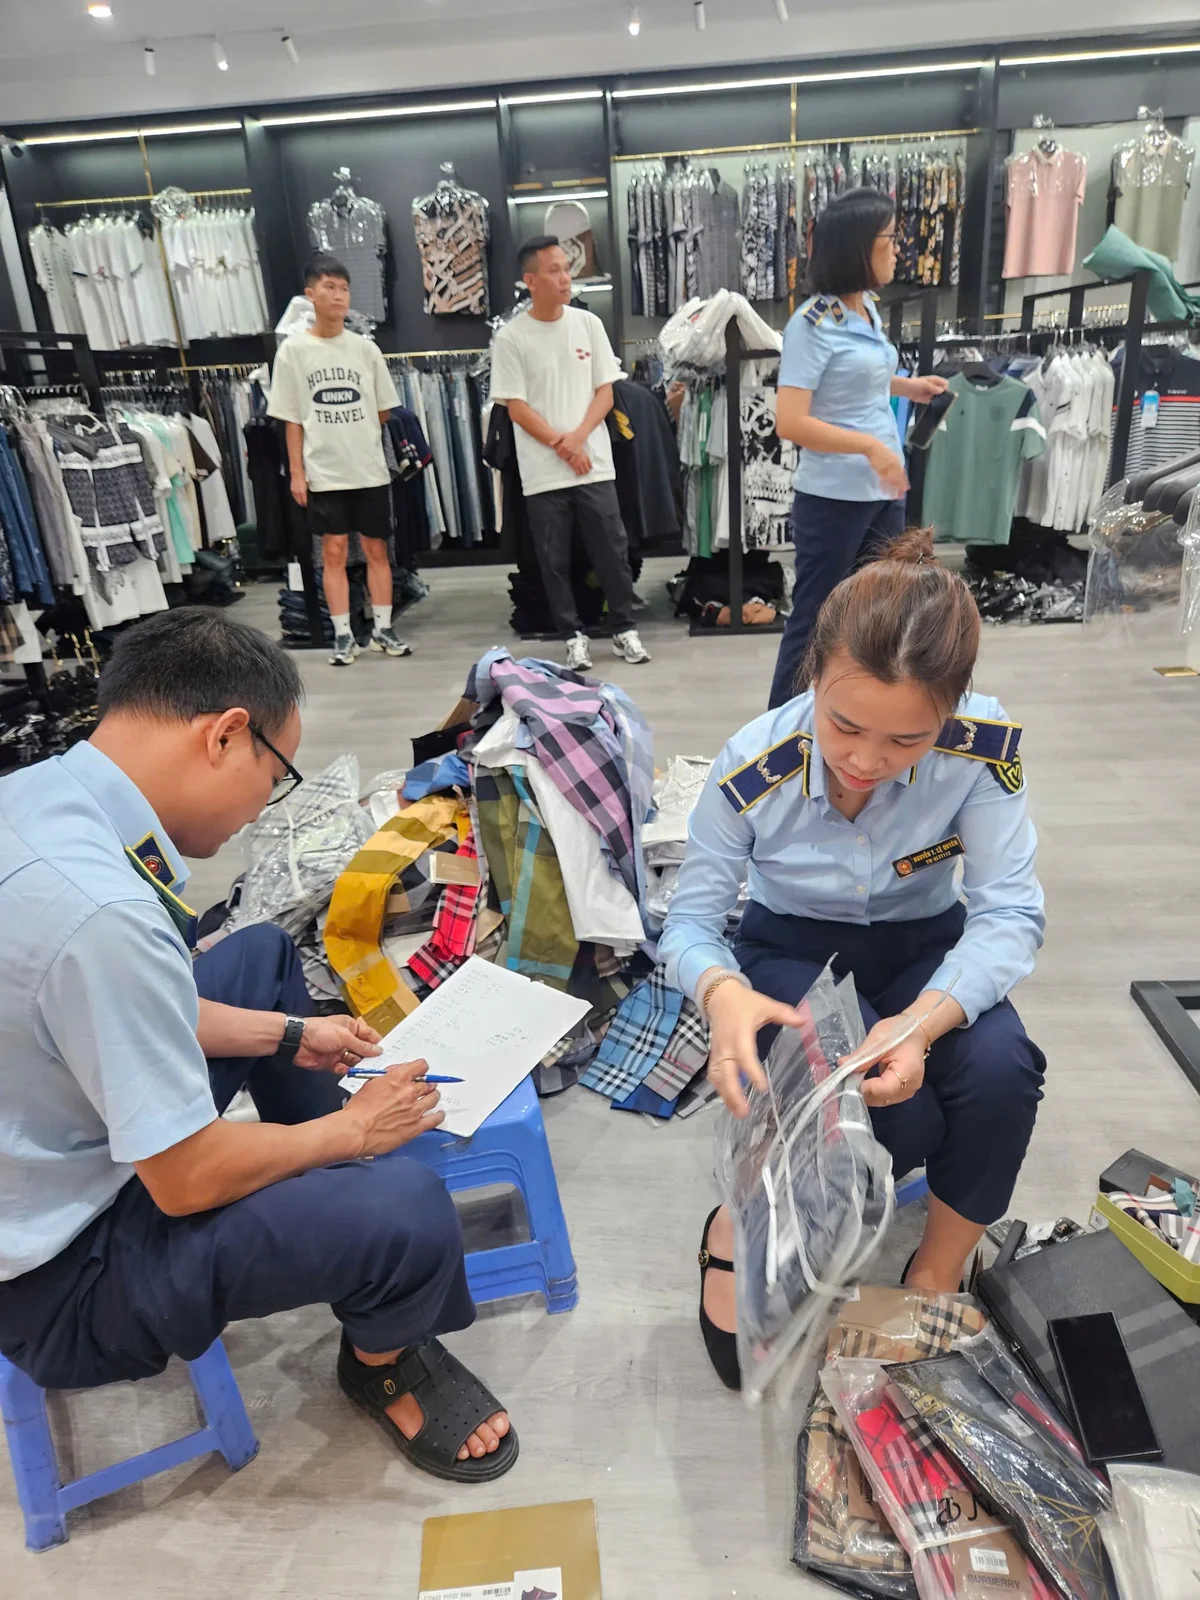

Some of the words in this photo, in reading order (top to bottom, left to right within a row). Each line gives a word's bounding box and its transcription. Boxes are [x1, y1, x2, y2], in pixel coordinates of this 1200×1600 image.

[306, 367, 361, 390] HOLIDAY
[321, 390, 353, 403] UNKN
[314, 407, 365, 424] TRAVEL
[967, 1574, 1021, 1589] BURBERRY
